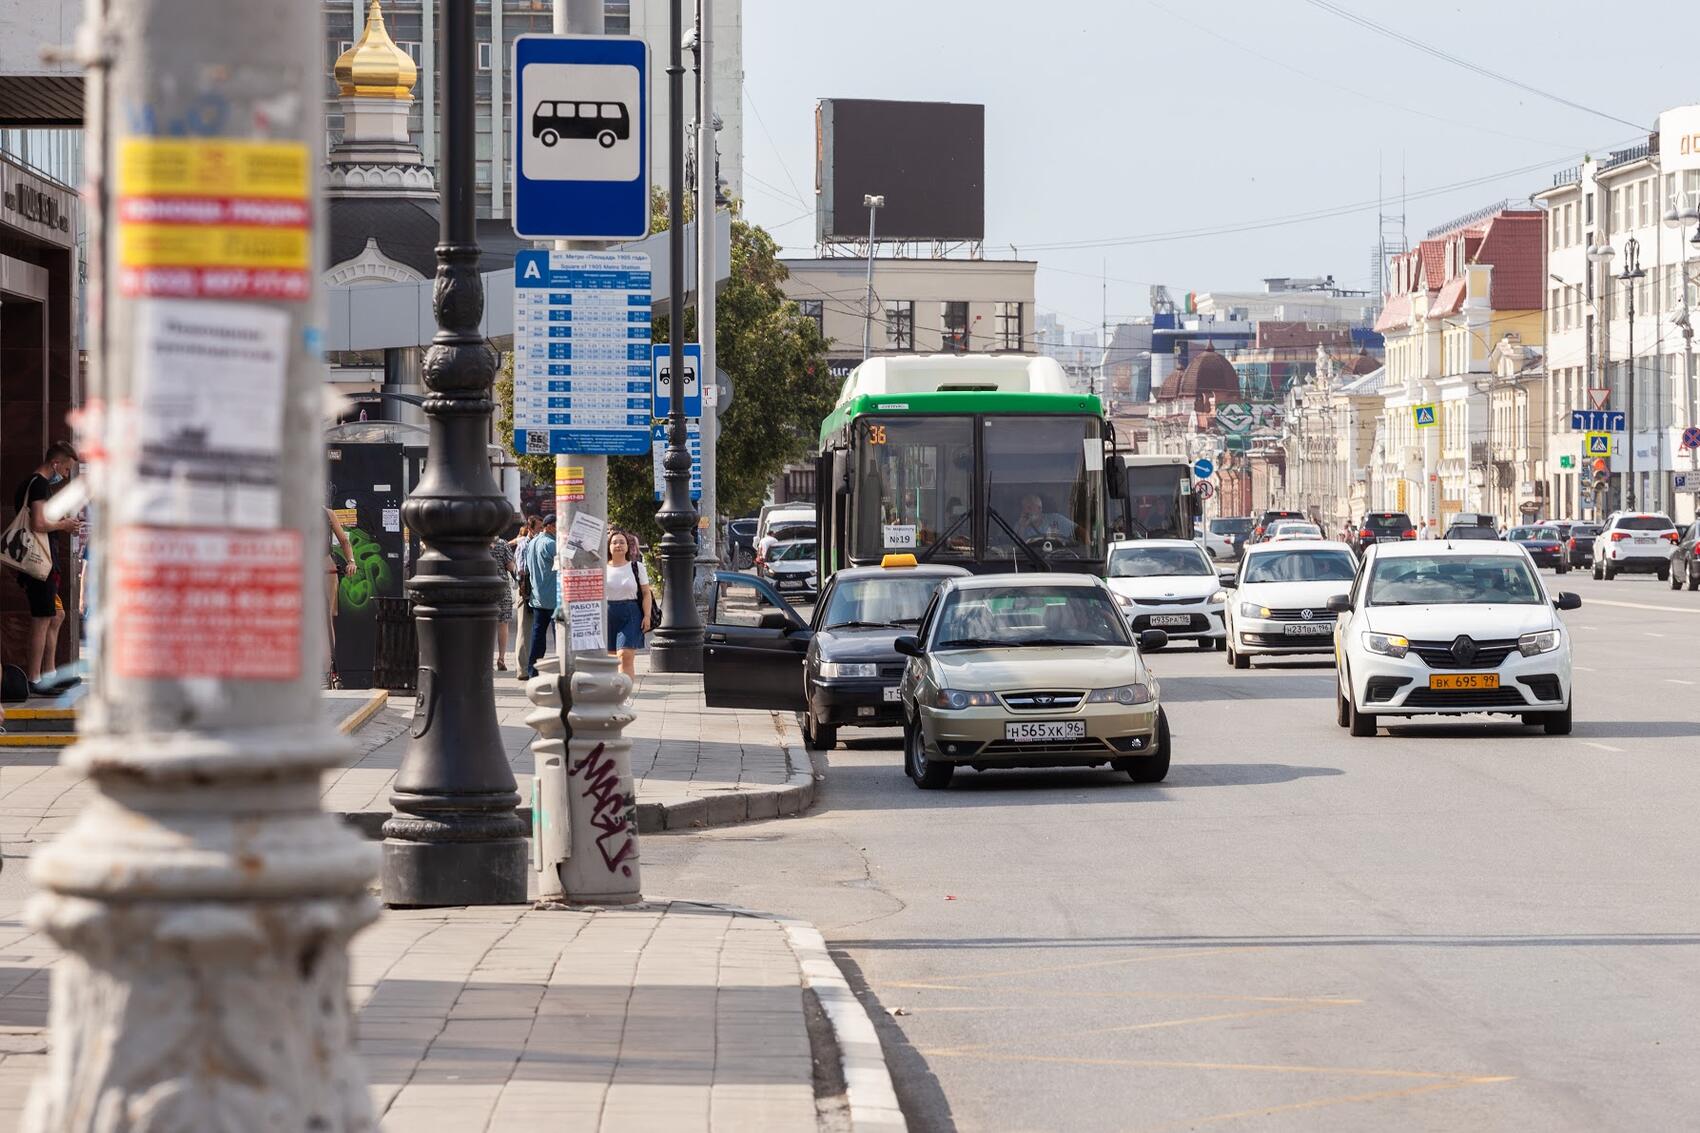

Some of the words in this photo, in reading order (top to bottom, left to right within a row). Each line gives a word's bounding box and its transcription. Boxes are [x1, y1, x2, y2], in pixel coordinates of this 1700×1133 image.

[869, 425, 886, 444] 36
[570, 602, 600, 610] РАБОТА
[1455, 676, 1477, 687] 695
